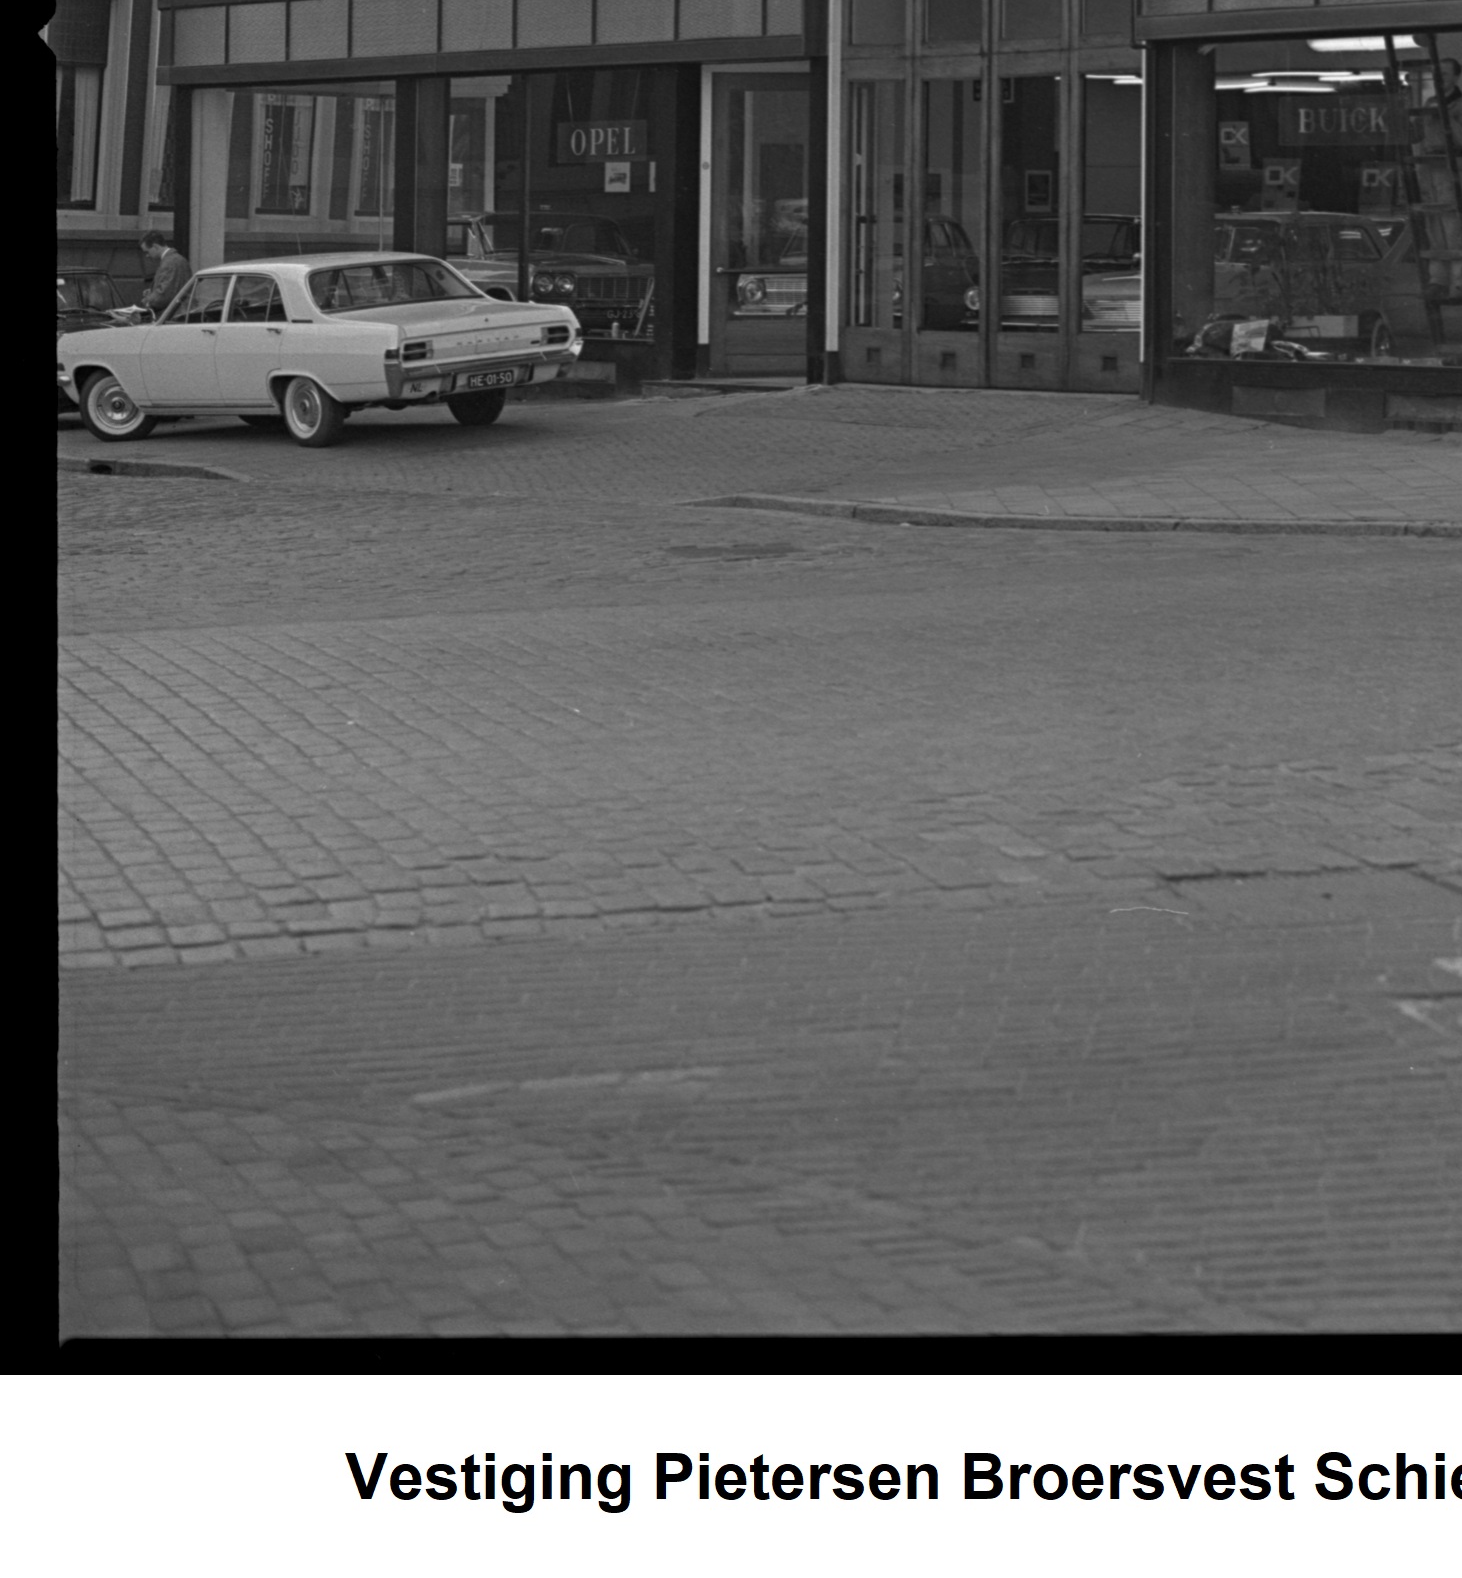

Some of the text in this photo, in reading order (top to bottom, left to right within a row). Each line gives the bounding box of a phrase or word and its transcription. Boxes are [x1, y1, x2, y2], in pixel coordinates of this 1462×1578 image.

[1297, 106, 1389, 134] BUICK
[570, 126, 637, 156] OPEL
[469, 371, 512, 388] HE-01-50
